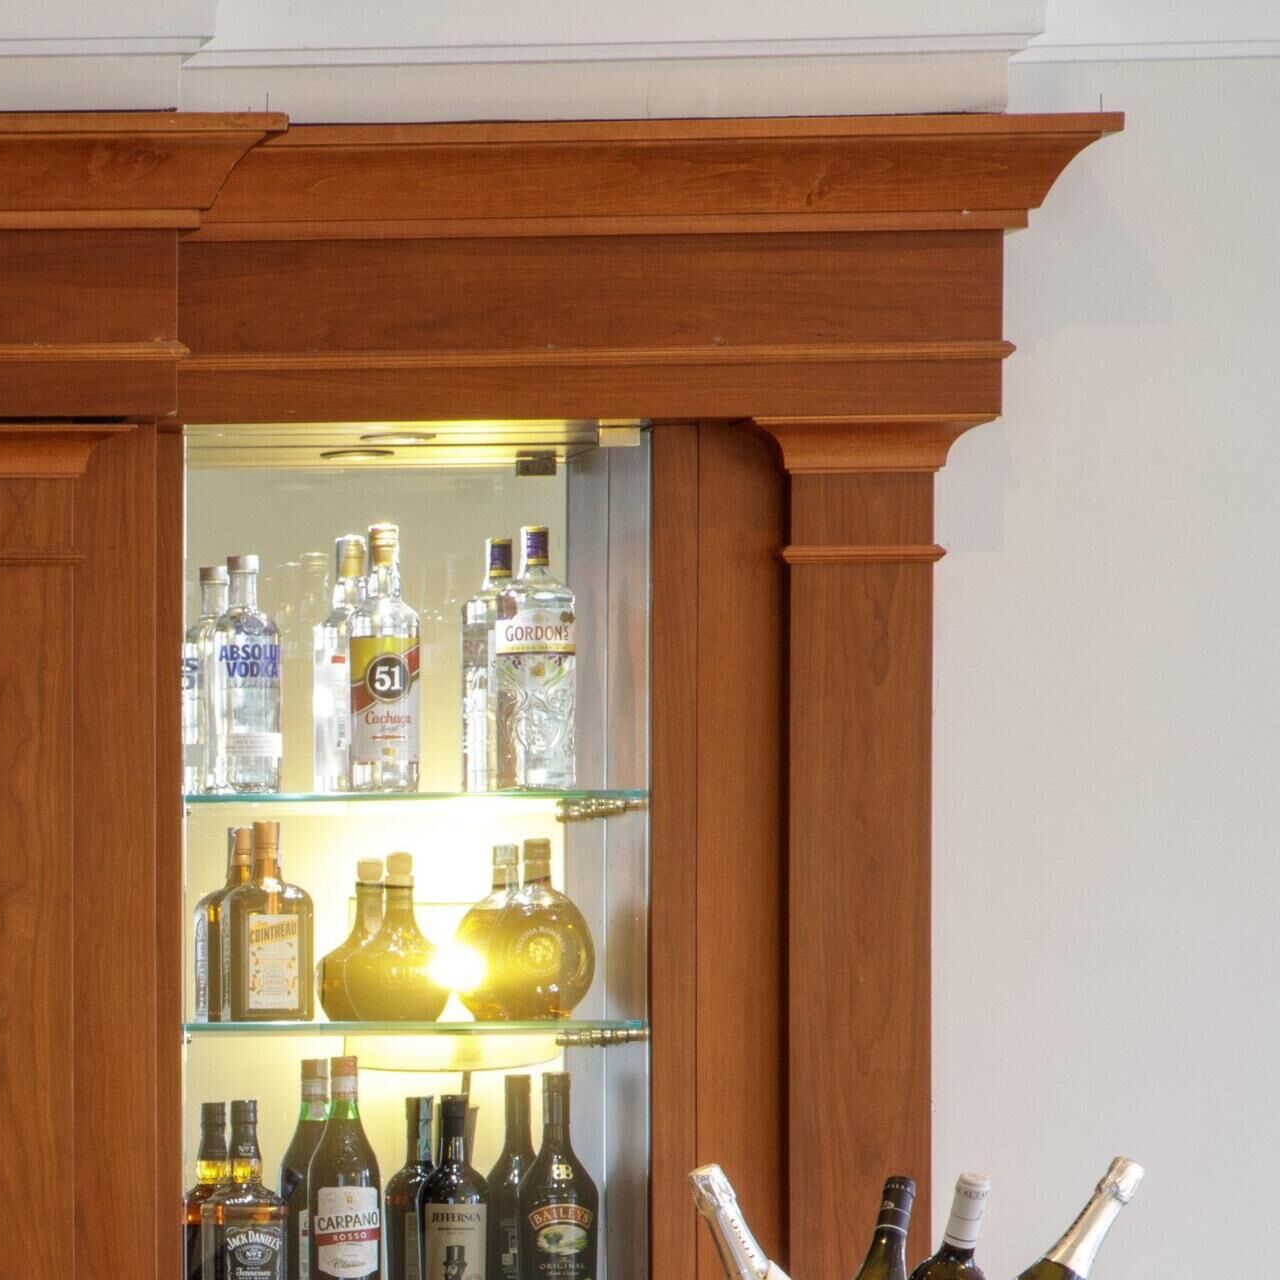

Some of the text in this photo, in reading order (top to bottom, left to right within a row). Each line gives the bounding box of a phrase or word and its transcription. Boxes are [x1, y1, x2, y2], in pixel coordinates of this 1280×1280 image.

[374, 665, 403, 691] 51
[249, 920, 297, 944] COINTREAU
[318, 1211, 378, 1231] CARPANO
[533, 1208, 590, 1225] BAILEYS
[226, 1230, 282, 1250] JACK DANIEL'S
[333, 1232, 367, 1241] ROSSO
[236, 1267, 272, 1277] Tennessee
